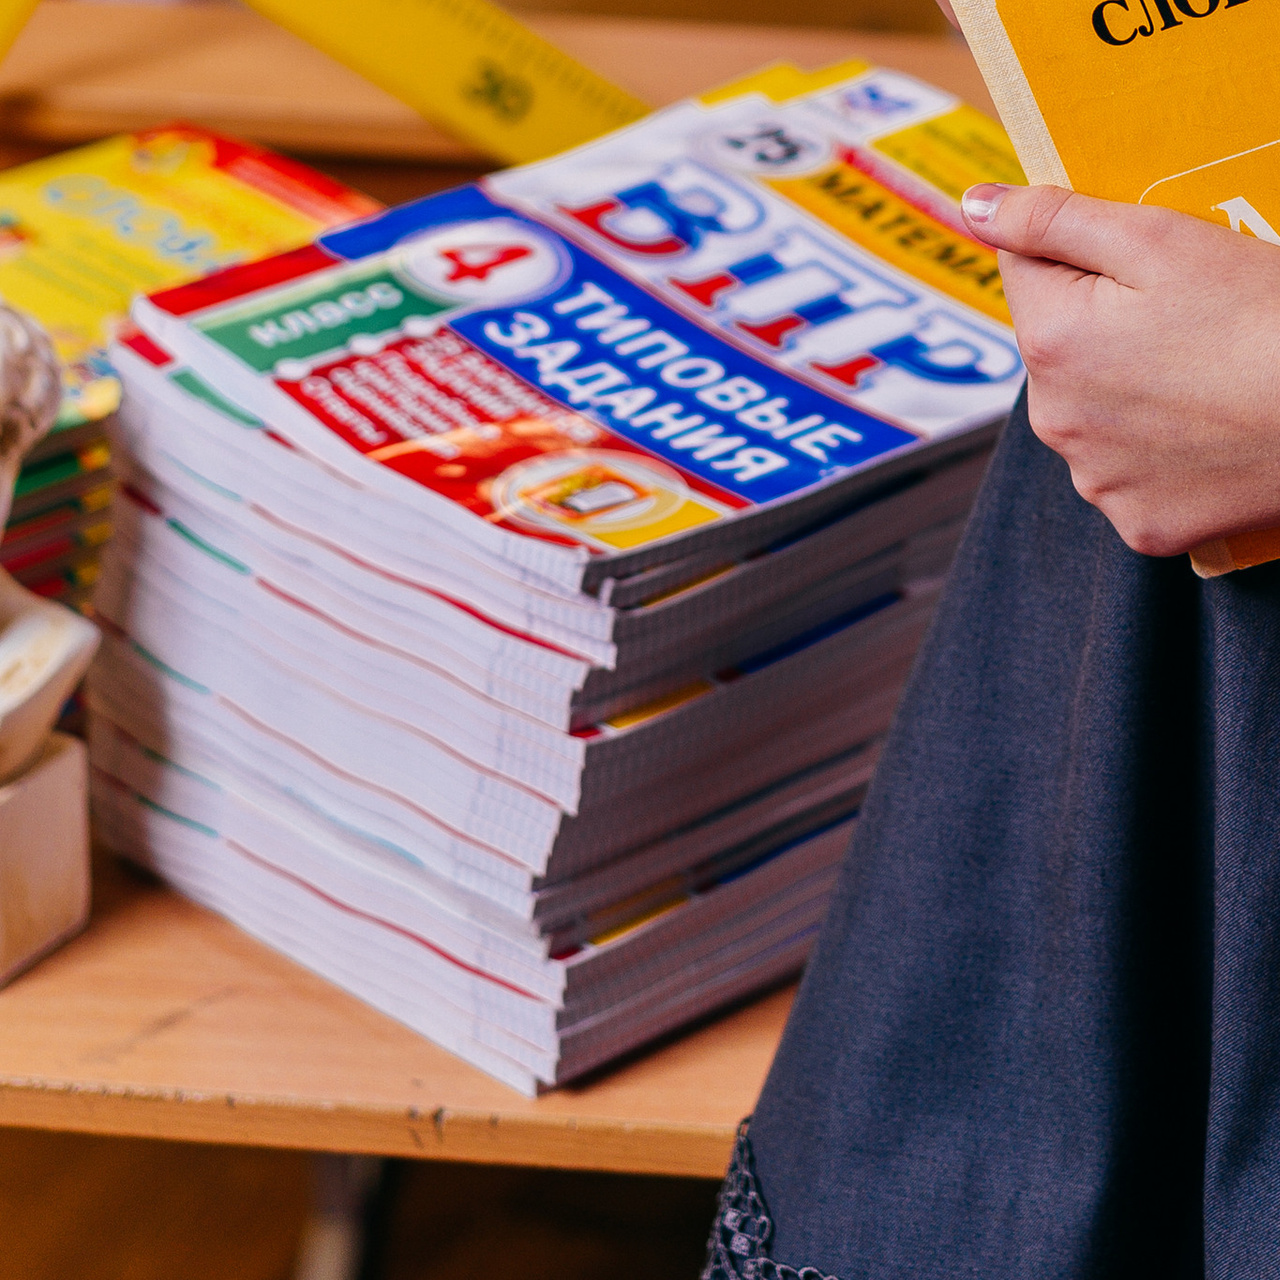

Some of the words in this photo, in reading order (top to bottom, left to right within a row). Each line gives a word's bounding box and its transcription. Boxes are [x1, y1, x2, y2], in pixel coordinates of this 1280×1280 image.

[439, 244, 534, 283] 4
[556, 158, 1028, 388] ВПР
[816, 172, 1005, 298] МАТЕМА
[483, 311, 789, 482] ЗАДАНИЯ
[553, 282, 863, 464] ТИПОВЫЕ
